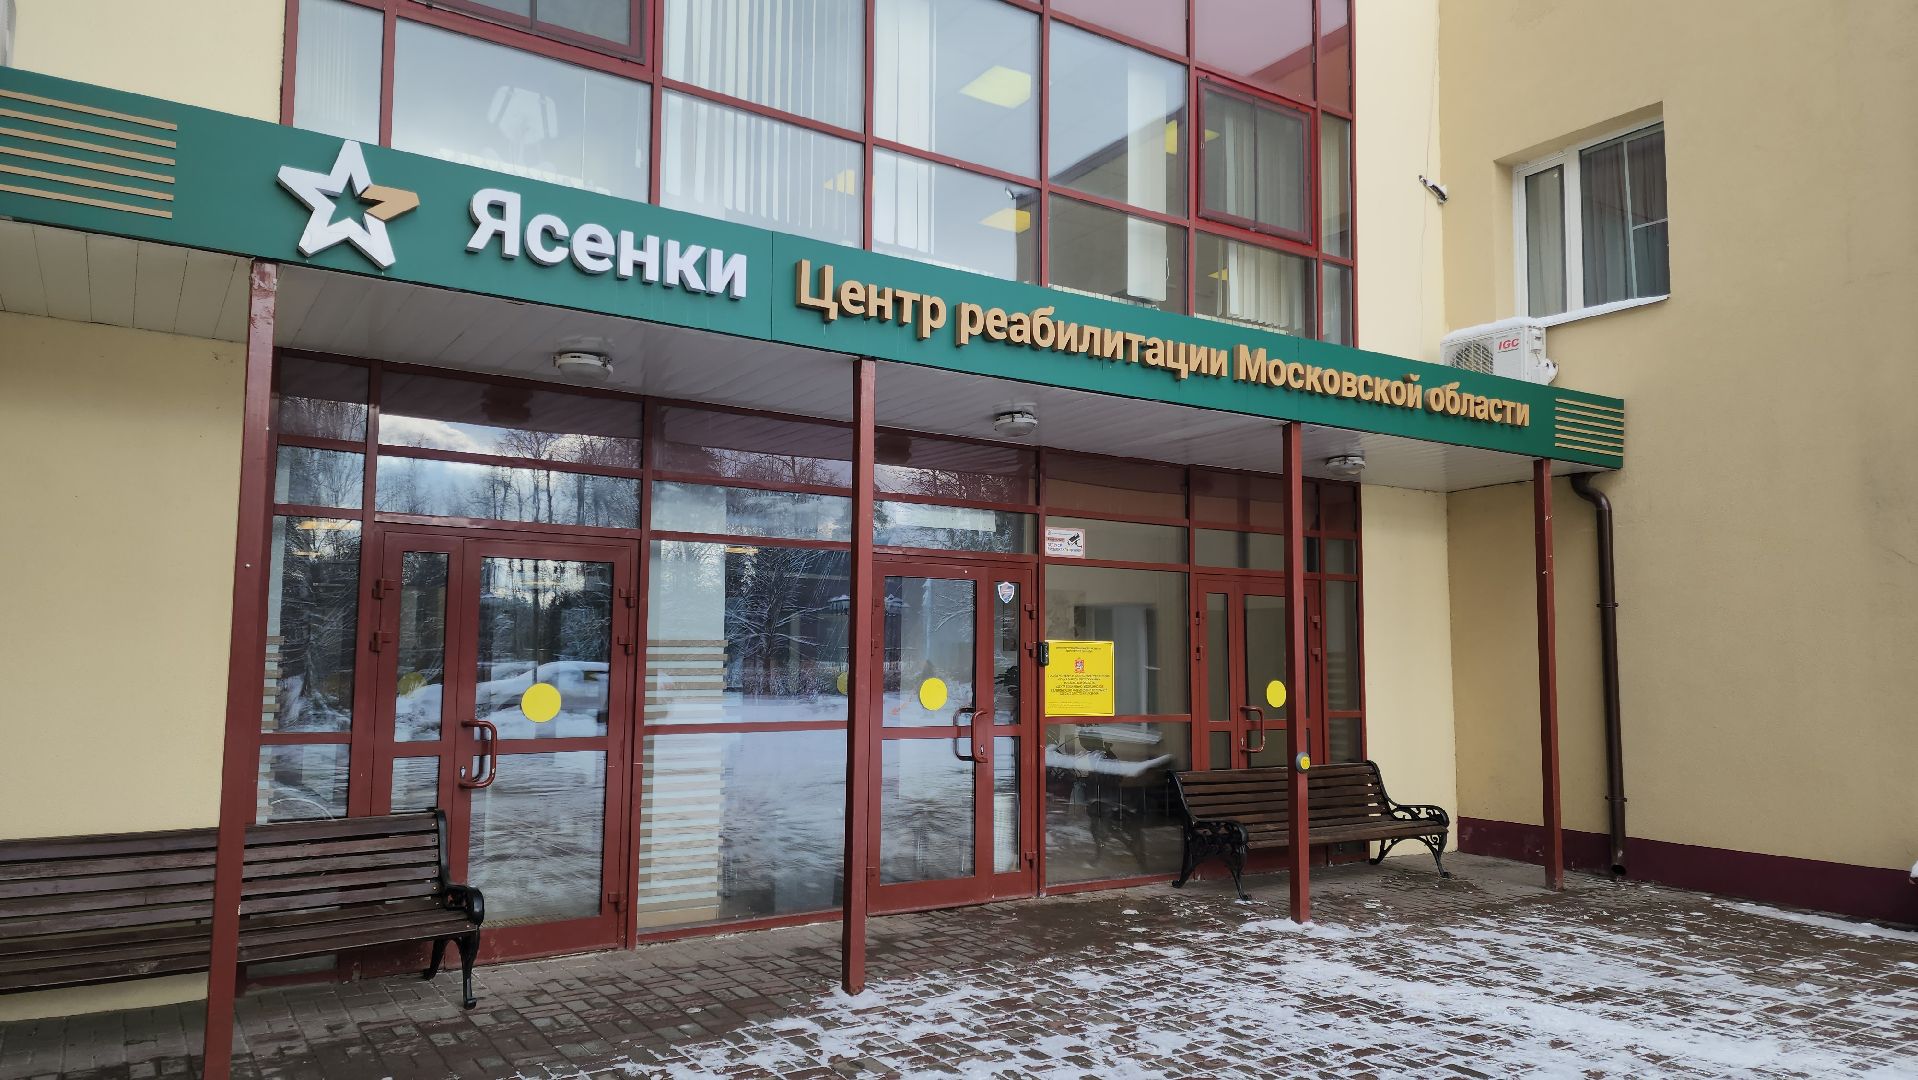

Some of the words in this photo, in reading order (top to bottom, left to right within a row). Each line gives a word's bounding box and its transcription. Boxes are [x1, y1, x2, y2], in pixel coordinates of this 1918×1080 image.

[466, 188, 747, 299] Ясенки
[797, 258, 947, 341] Центр
[955, 302, 1228, 380] реабилитации
[1234, 344, 1422, 409] Московской
[1424, 381, 1530, 427] области
[1498, 338, 1520, 351] IGC
